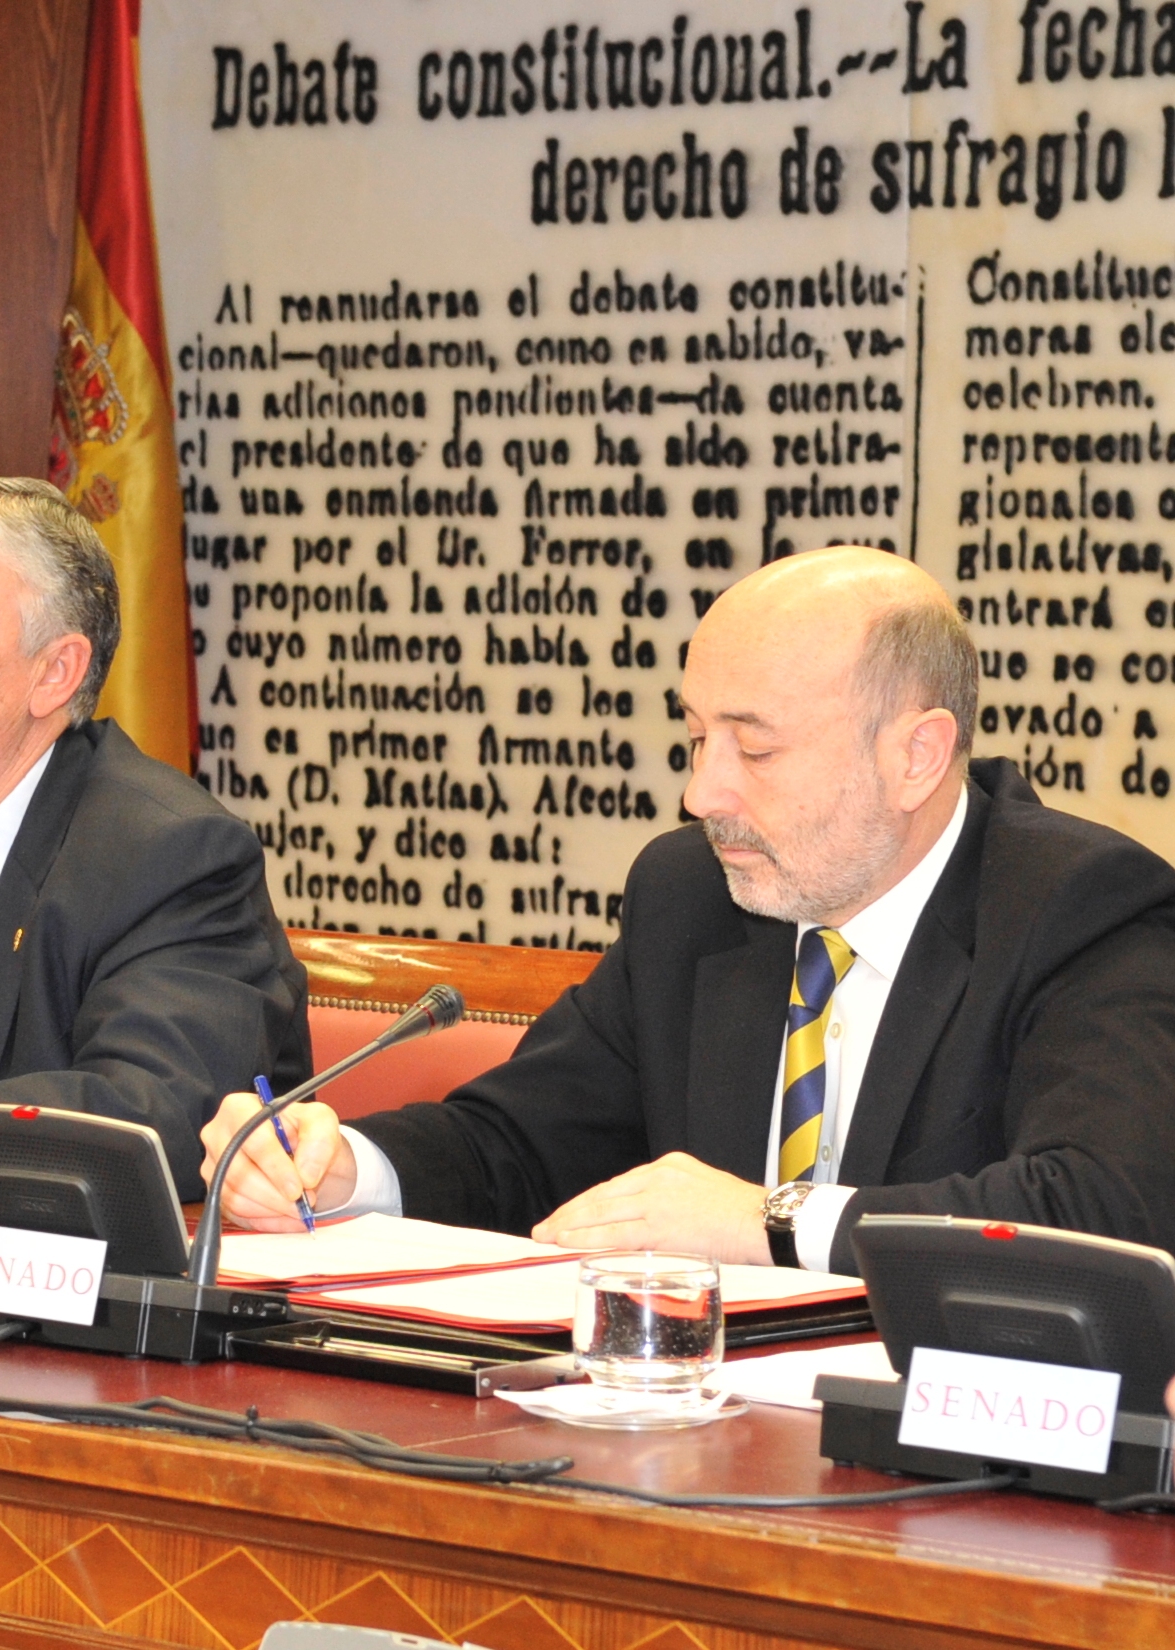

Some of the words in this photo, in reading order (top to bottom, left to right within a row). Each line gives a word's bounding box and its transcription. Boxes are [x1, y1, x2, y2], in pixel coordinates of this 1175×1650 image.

[210, 40, 379, 132] Debate
[530, 131, 749, 227] derecho
[779, 125, 845, 216] de
[869, 110, 1128, 222] sufragio
[214, 283, 252, 325] Al
[506, 271, 540, 318] el
[569, 268, 699, 317] debate
[515, 336, 613, 367] como
[767, 375, 904, 416] cuenta
[502, 438, 570, 477] que
[594, 422, 642, 468] ha
[239, 486, 305, 517] una
[691, 487, 740, 521] en
[764, 470, 902, 532] primer
[292, 535, 353, 574] por
[376, 524, 410, 568] el
[684, 536, 735, 571] en
[410, 569, 445, 615] la
[621, 575, 668, 619] de
[225, 621, 306, 669] cuyo
[611, 623, 657, 669] de
[979, 648, 1028, 682] ue
[1121, 652, 1175, 685] co
[209, 663, 238, 708] A
[979, 692, 1103, 738] evado
[328, 717, 450, 770] primer
[250, 806, 337, 862] ujer,
[354, 825, 377, 865] y
[394, 816, 467, 861] dice
[442, 869, 485, 910] de
[910, 1381, 1106, 1437] SENADO
